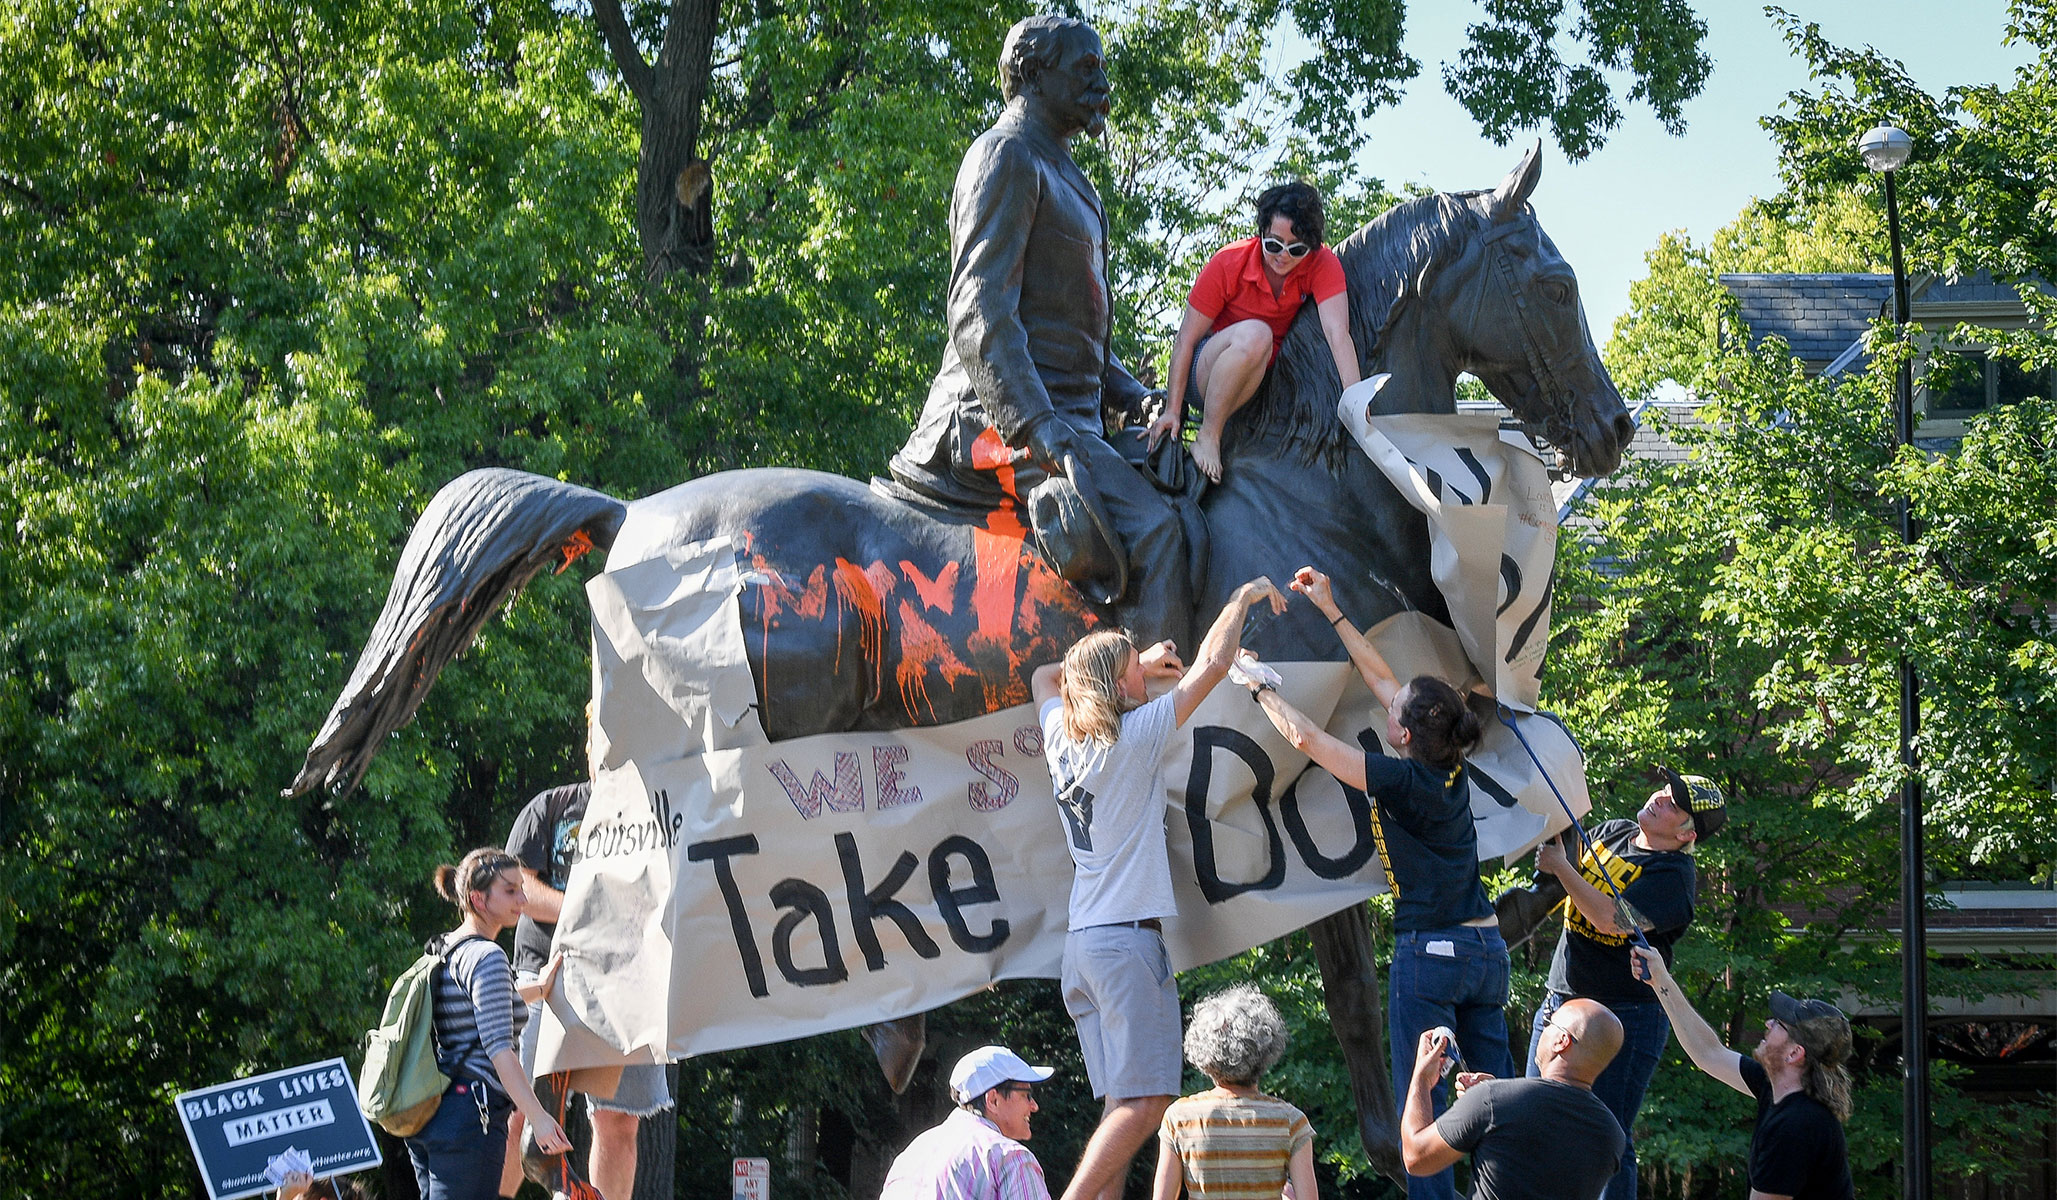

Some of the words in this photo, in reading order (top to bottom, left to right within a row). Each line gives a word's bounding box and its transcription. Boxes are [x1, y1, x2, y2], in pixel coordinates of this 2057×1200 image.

[765, 745, 923, 821] WE
[687, 832, 1011, 998] Take
[185, 1086, 265, 1122] BLACK
[279, 1068, 345, 1100] LIVES
[235, 1104, 325, 1140] MATTER
[743, 1179, 760, 1190] ANY
